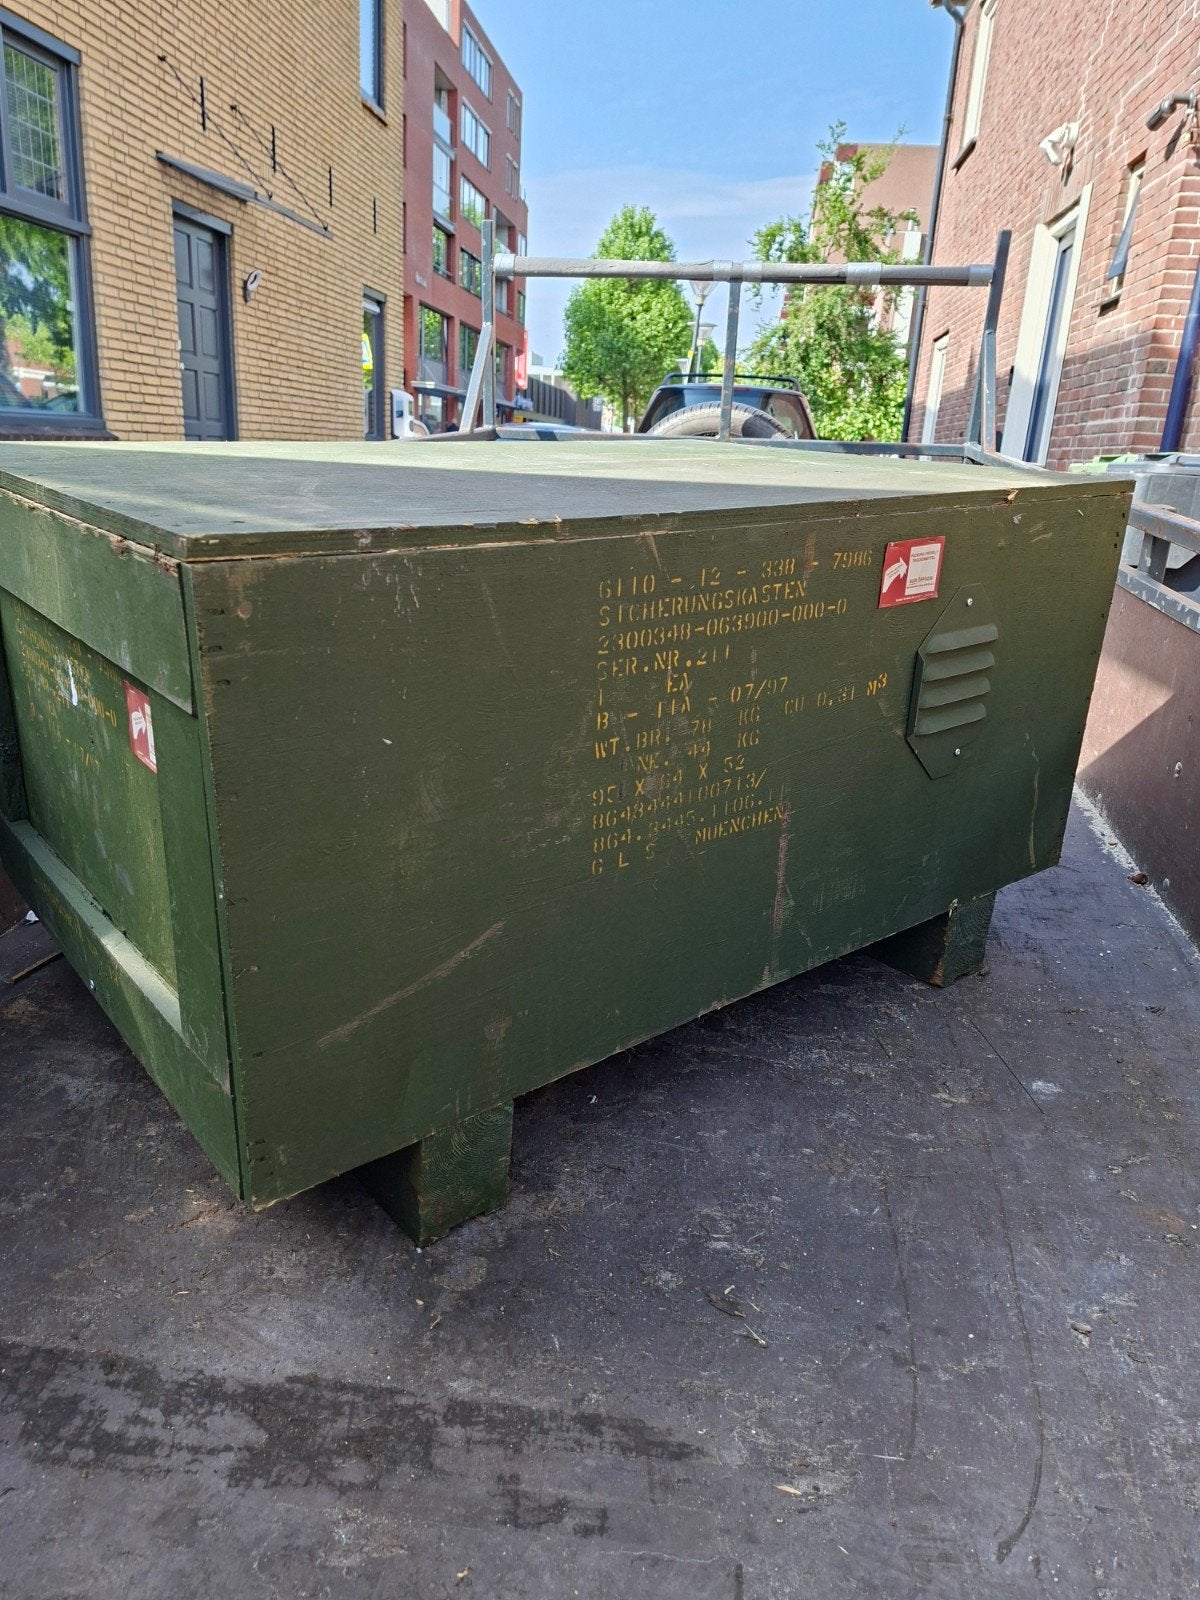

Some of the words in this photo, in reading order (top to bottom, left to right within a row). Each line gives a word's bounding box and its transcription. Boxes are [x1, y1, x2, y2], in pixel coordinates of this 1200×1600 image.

[599, 574, 656, 599] 6110
[701, 566, 721, 587] 12
[761, 557, 797, 579] 338
[833, 549, 873, 570] 7986
[597, 598, 848, 655] 2300348-063900-000-0
[599, 580, 807, 627] SICHERUNGSKASTEN
[597, 711, 610, 731] B
[657, 696, 692, 720] 11A
[730, 676, 788, 704] 07/97
[667, 672, 690, 694] EA
[688, 740, 711, 760] 44
[736, 729, 760, 749] KG
[691, 719, 712, 737] 78
[738, 704, 760, 726] KG
[592, 785, 617, 806] 95
[723, 754, 745, 773] 52
